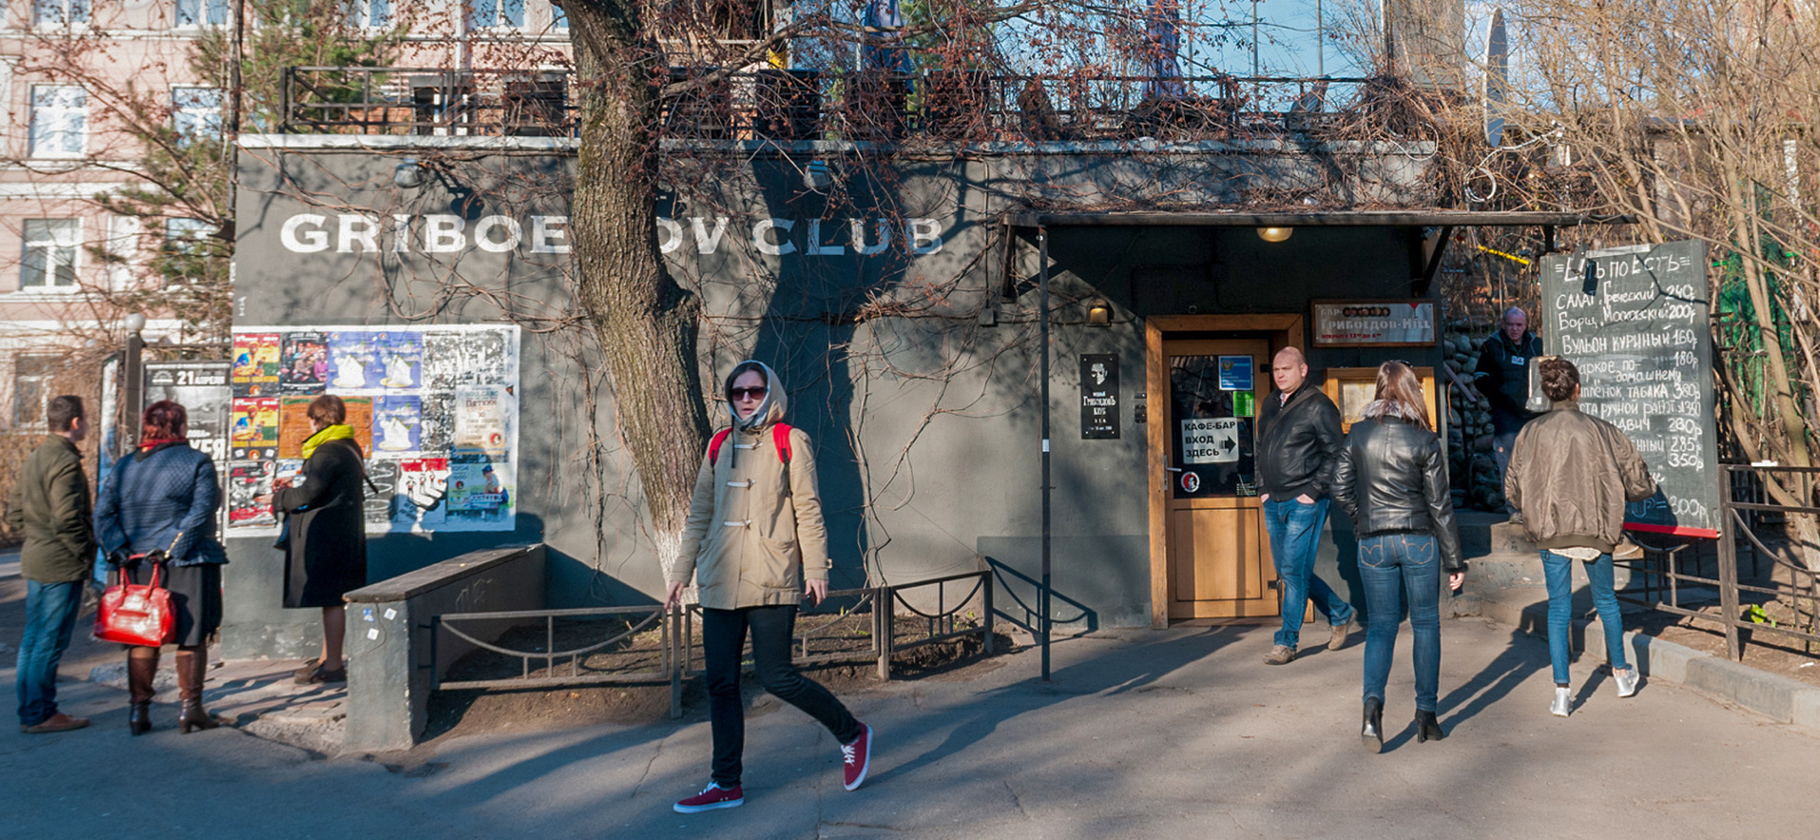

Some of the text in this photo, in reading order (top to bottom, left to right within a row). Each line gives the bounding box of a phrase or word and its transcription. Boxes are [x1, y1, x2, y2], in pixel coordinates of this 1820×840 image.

[281, 213, 943, 256] GRIBOEOV CLUB
[176, 370, 194, 385] 21
[1184, 421, 1236, 431] КАФЕ-БАР
[1185, 435, 1215, 444] ВХОД
[1185, 448, 1220, 458] ЗДЕСЬ
